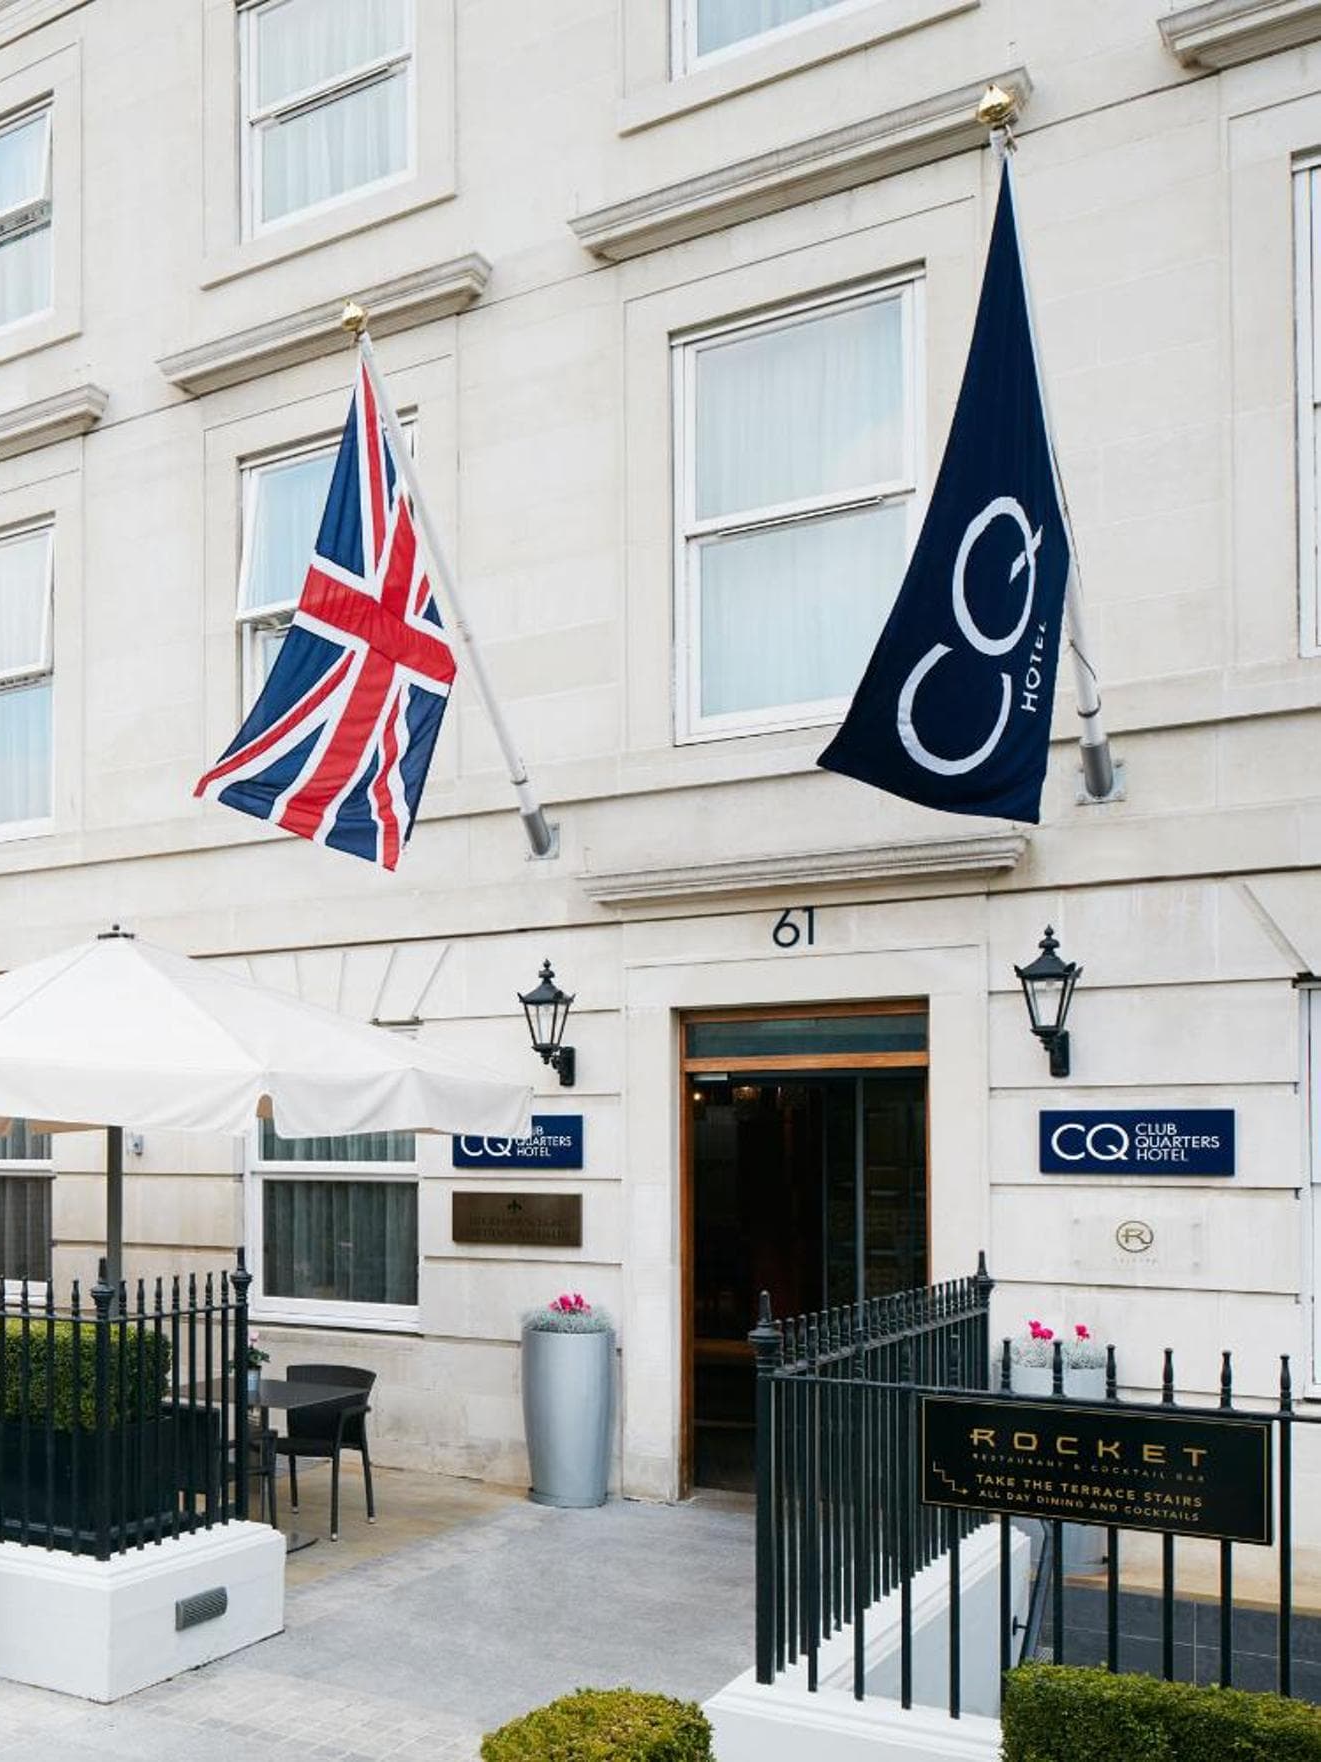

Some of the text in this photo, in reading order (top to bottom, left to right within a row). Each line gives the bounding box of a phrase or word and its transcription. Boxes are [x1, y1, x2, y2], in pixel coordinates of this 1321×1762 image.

[897, 496, 1044, 776] CQ
[1021, 621, 1047, 713] HOTEL
[772, 906, 815, 948] 61
[1051, 1123, 1129, 1161] CQ
[1135, 1122, 1177, 1136] CLUB
[1135, 1135, 1220, 1150] QUARTERS
[517, 1146, 551, 1157] HOTEL
[1136, 1148, 1188, 1162] HOTEL
[970, 1428, 1207, 1467] ROCKET
[1090, 1465, 1166, 1479] COCKTAIL
[976, 1474, 1203, 1508] TAKE THE TERRACE STAIRS
[978, 1489, 1200, 1522] ALL DAY DINING AND COCKTAILS
